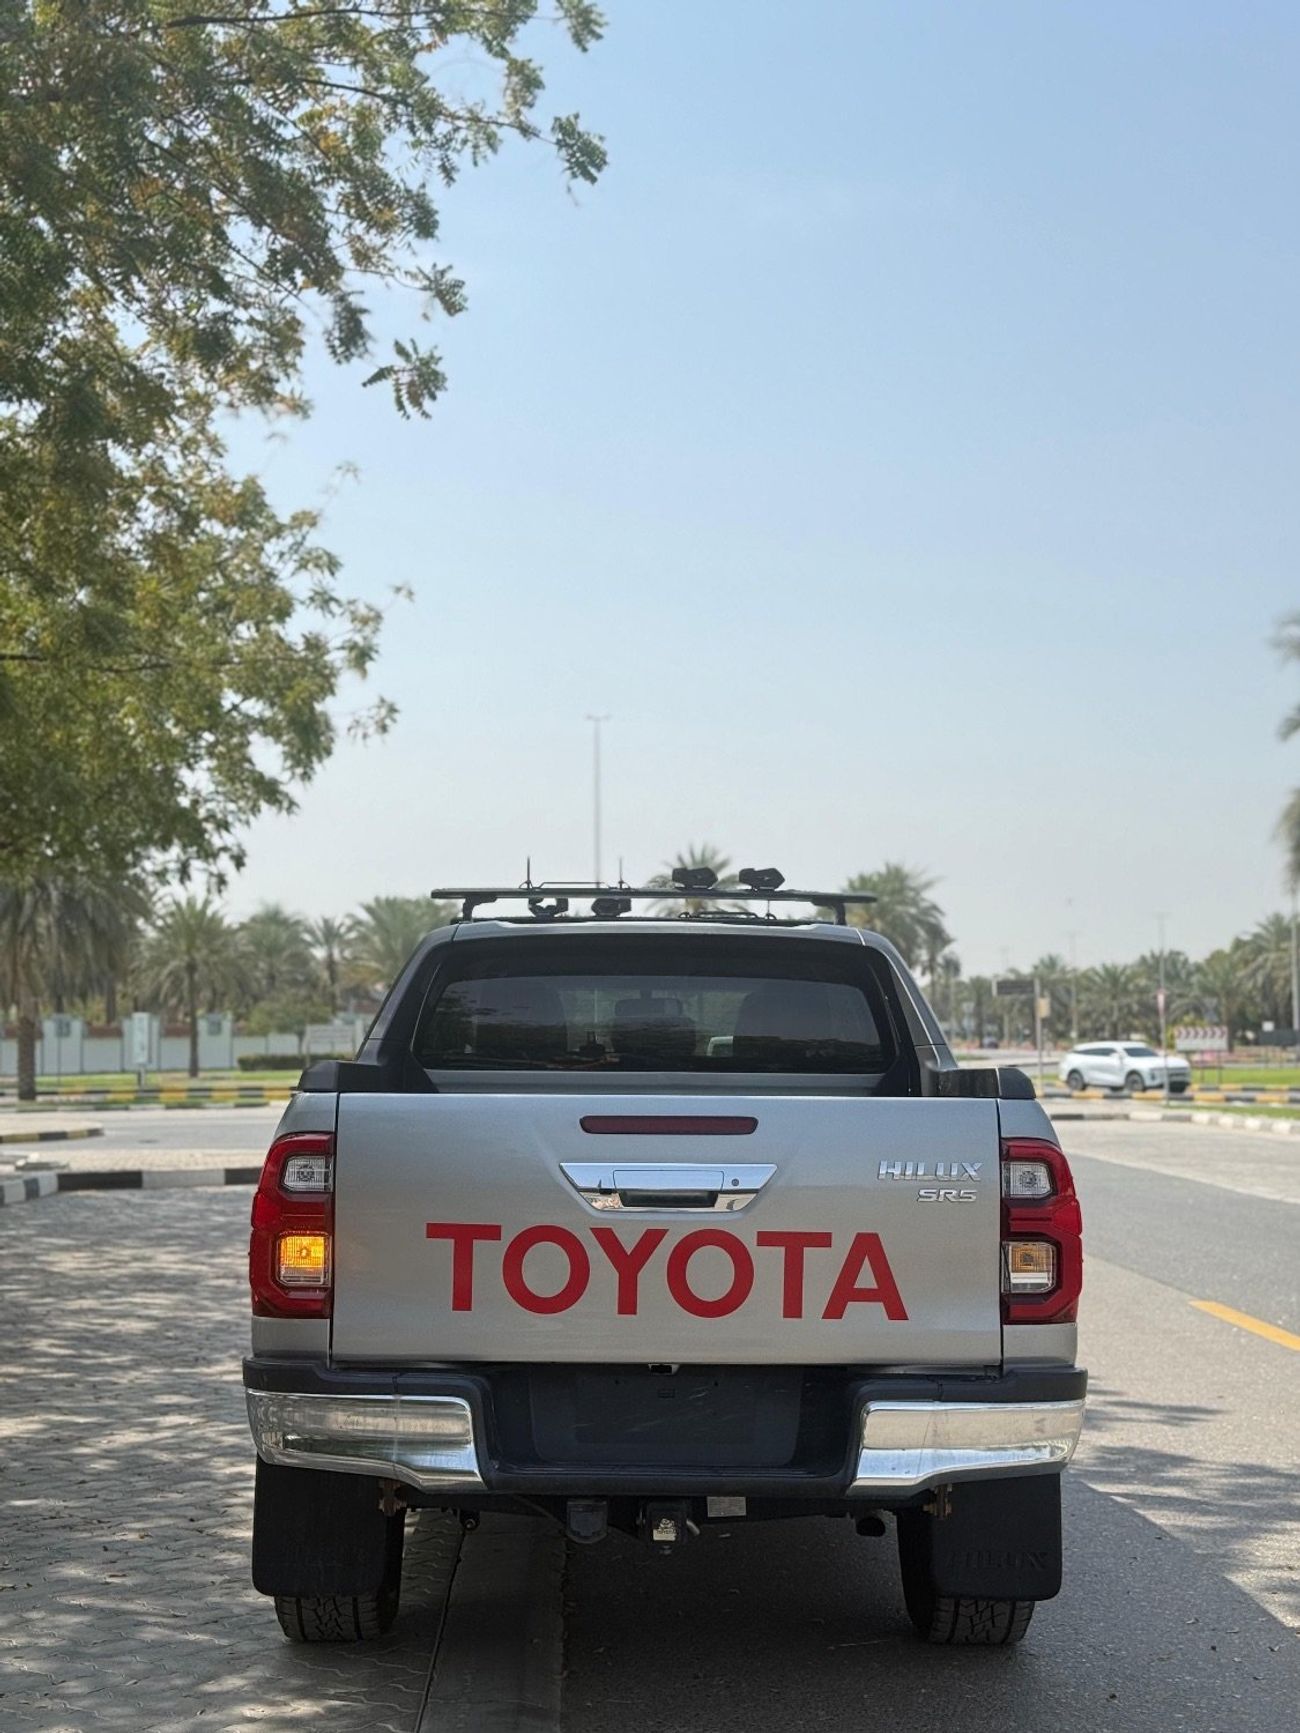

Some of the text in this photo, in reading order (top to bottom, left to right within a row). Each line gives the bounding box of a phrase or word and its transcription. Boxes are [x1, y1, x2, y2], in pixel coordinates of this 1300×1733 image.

[878, 1160, 983, 1182] HILUX
[917, 1188, 978, 1203] SR5
[426, 1222, 909, 1321] TOYOTA
